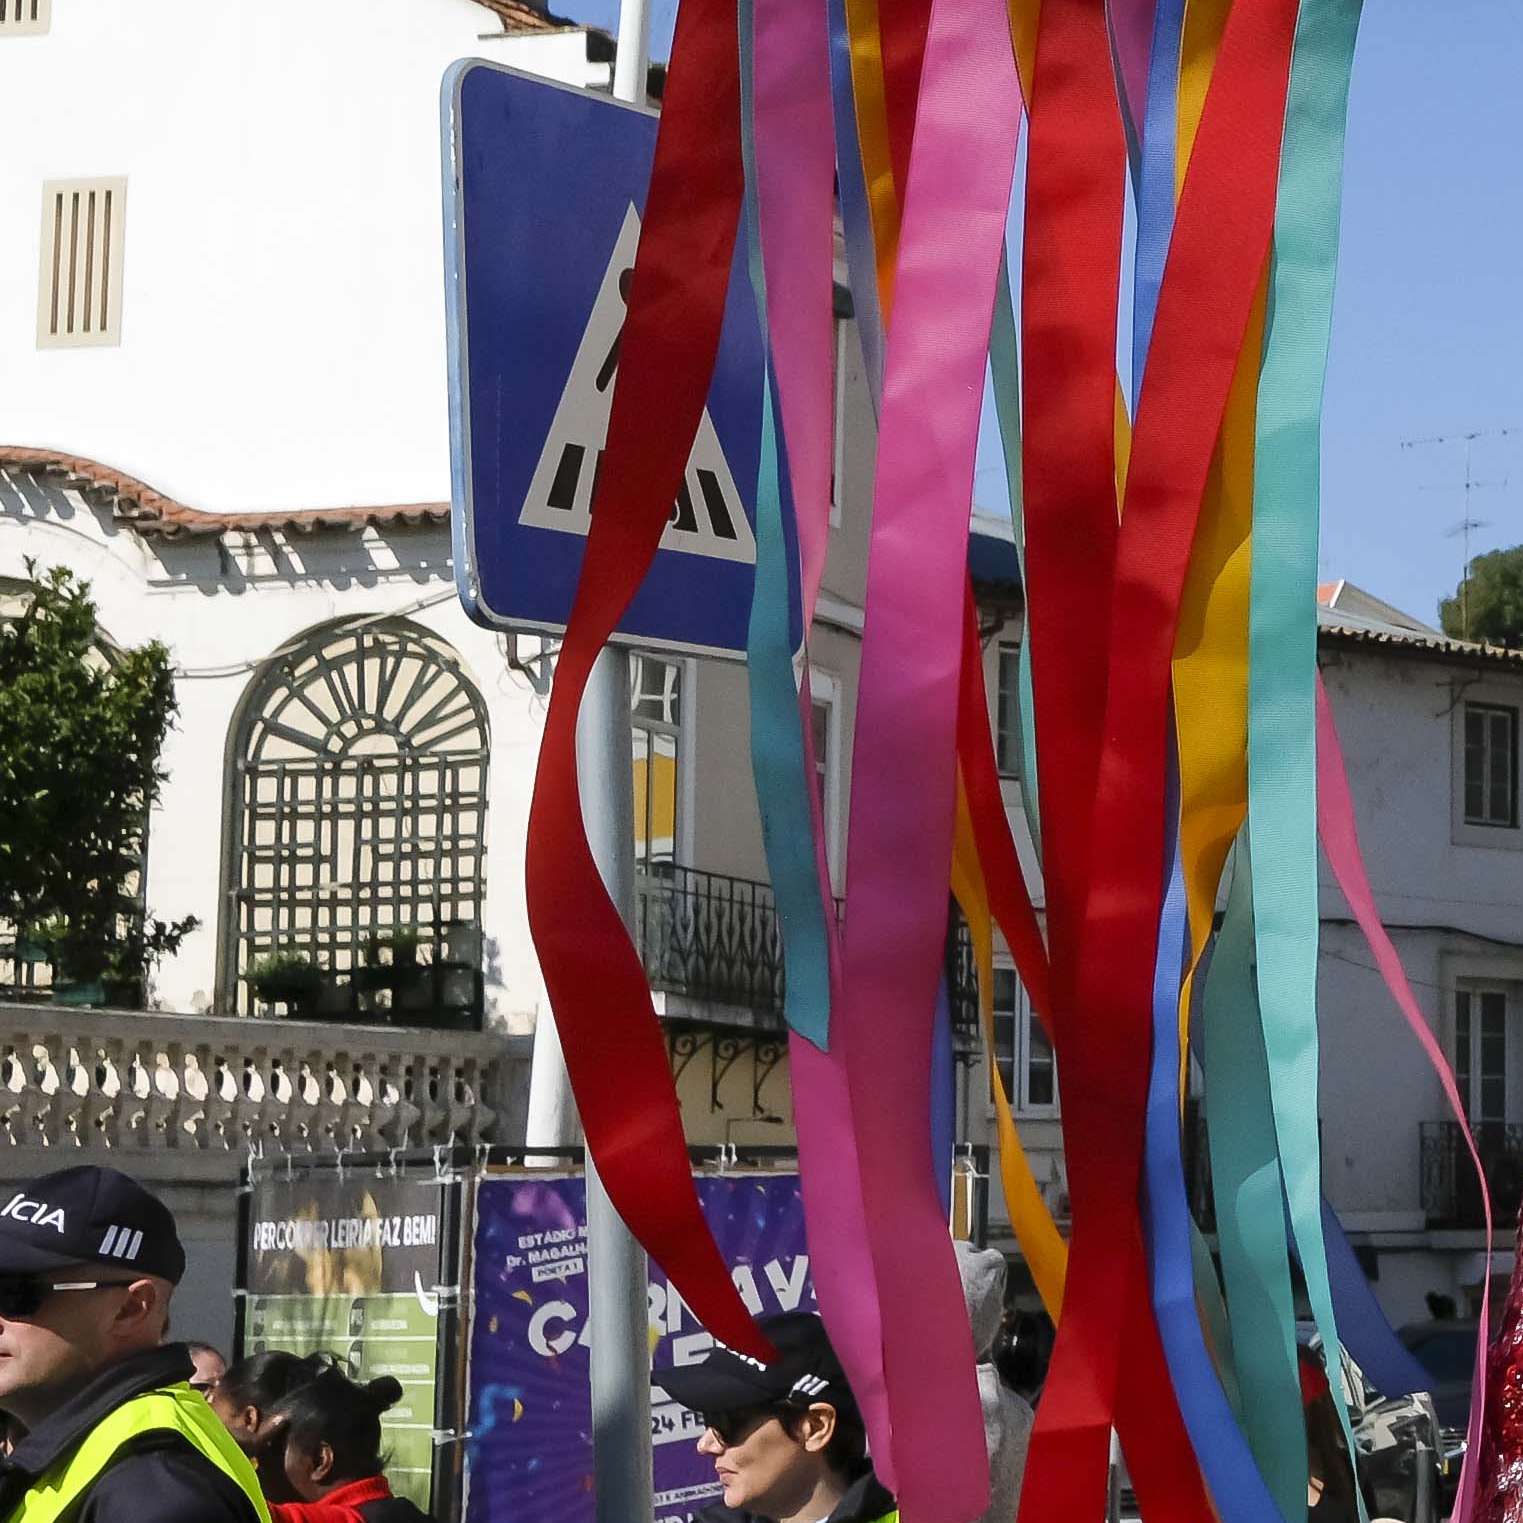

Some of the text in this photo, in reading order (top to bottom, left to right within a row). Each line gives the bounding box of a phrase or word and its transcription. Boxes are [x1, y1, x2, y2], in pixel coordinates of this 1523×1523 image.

[375, 1215, 401, 1247] FAZ
[403, 1214, 436, 1246] BEM!
[528, 1242, 588, 1263] MAGALH
